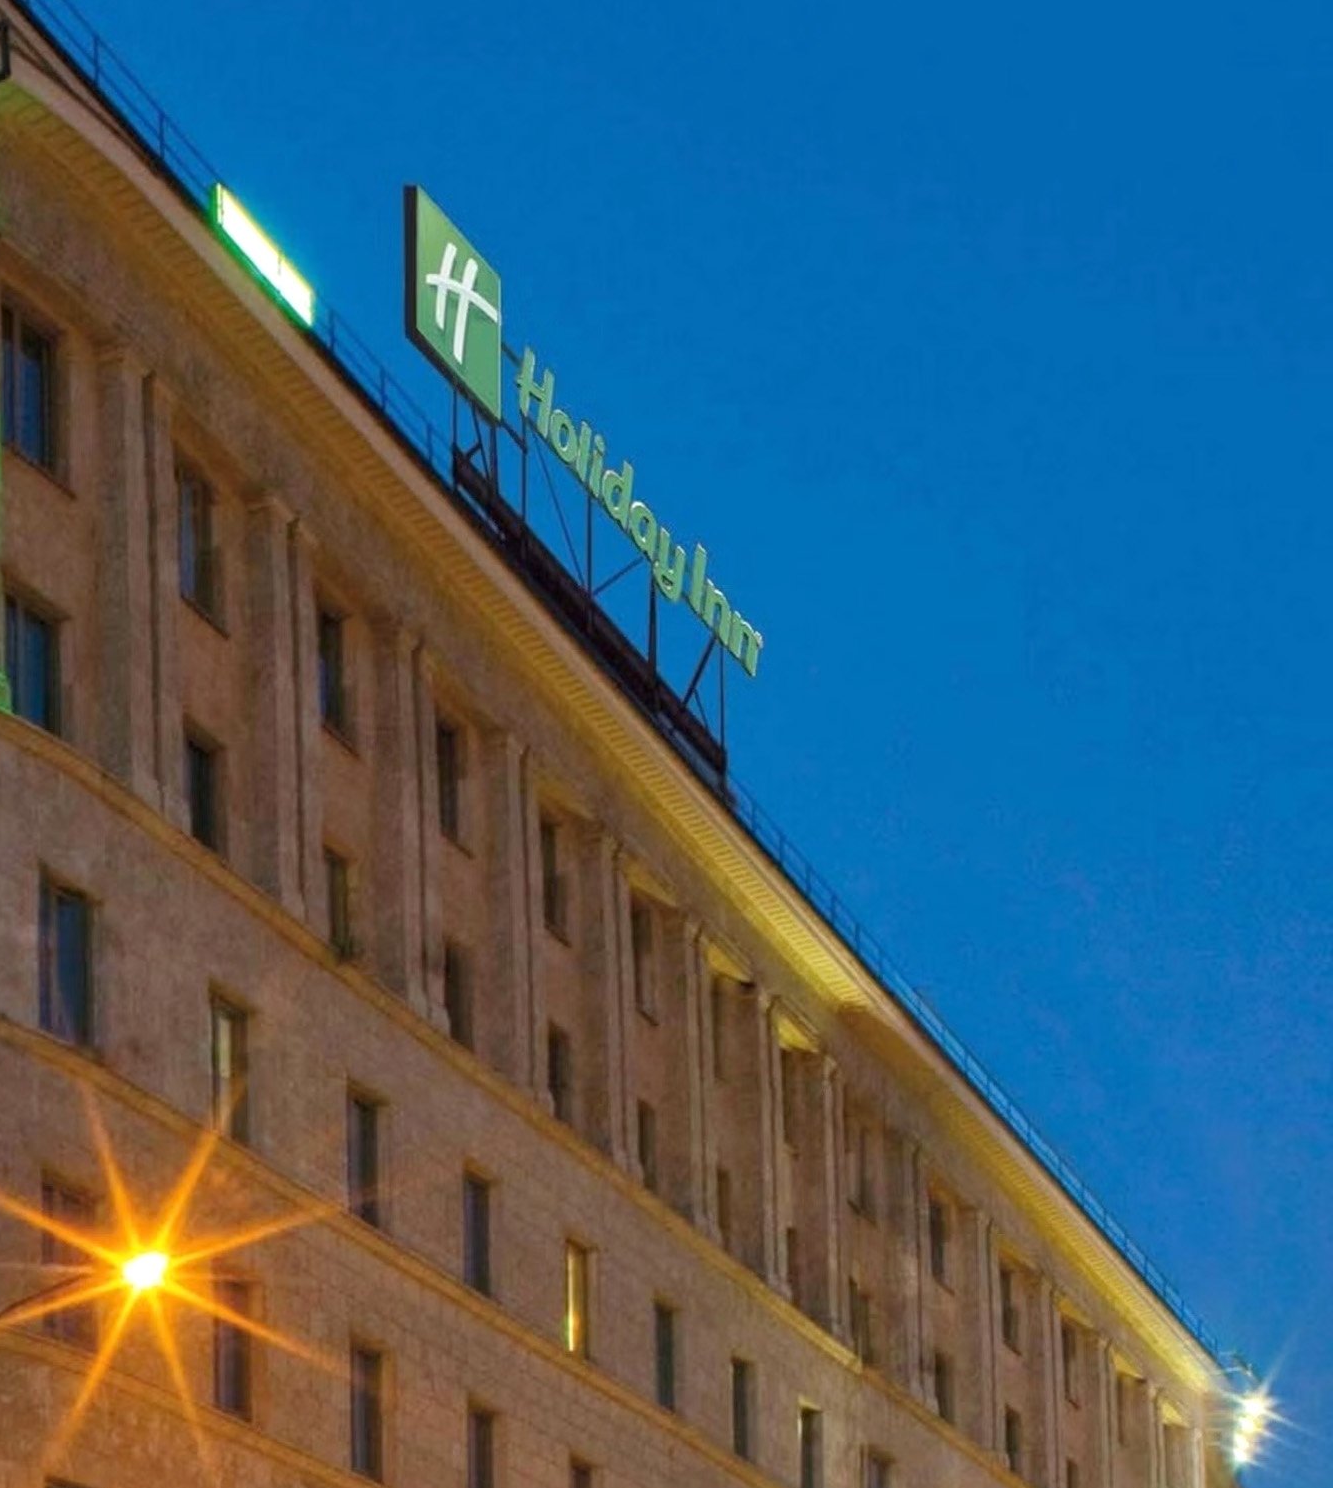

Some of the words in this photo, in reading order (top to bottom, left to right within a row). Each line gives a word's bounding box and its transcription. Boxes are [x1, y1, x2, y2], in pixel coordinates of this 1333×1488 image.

[425, 242, 501, 364] H
[516, 347, 685, 602] Holiday
[689, 542, 763, 677] Inn
